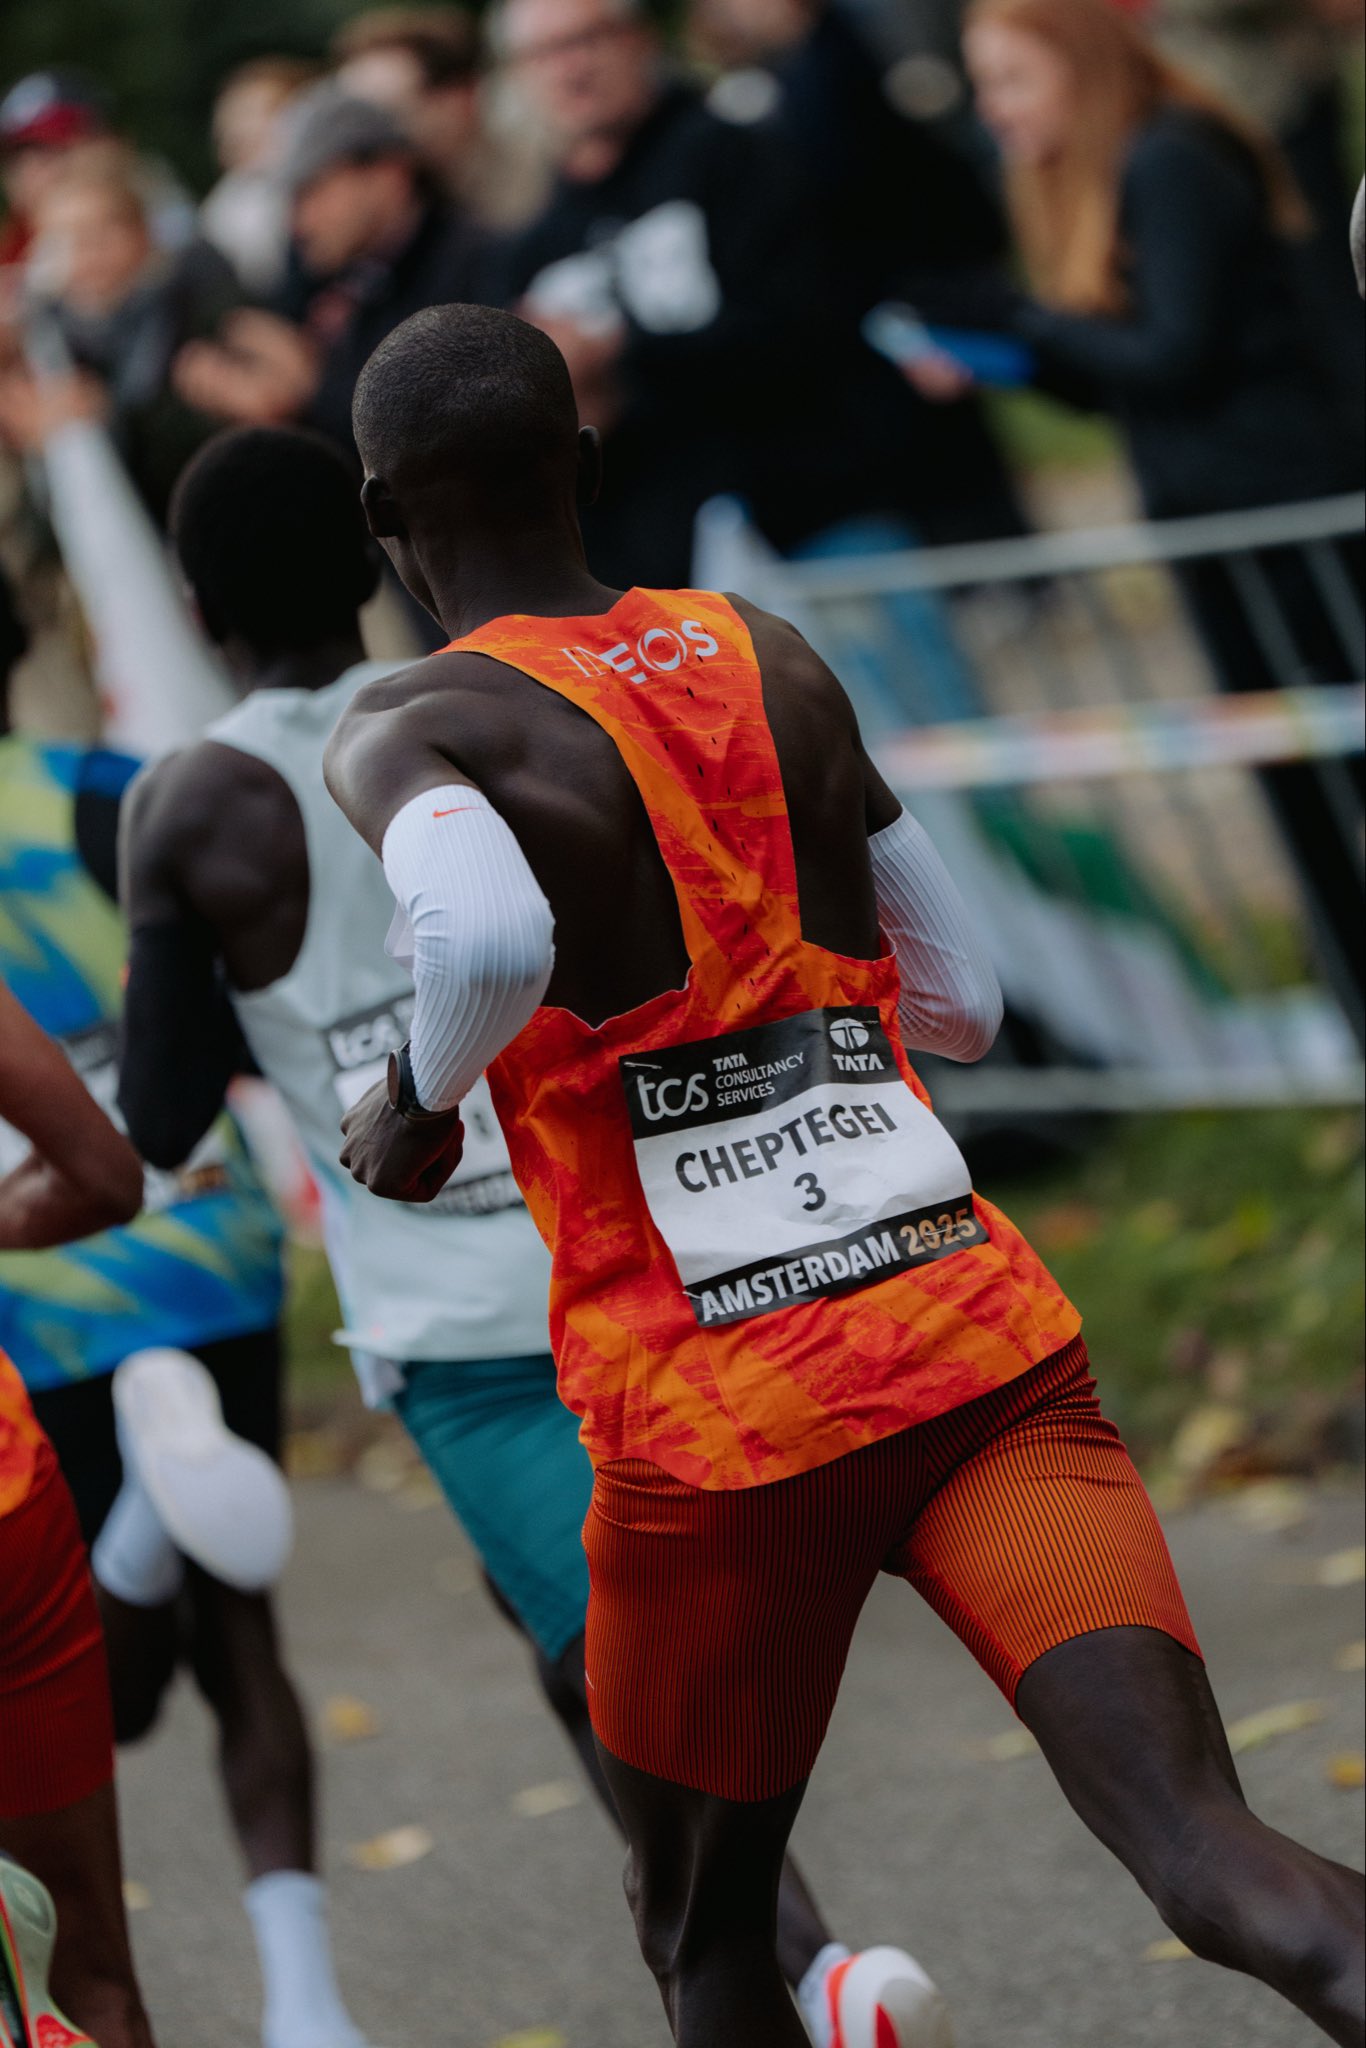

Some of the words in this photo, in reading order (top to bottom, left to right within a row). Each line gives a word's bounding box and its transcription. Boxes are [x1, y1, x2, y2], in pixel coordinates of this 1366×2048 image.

[561, 620, 718, 684] INEOS
[713, 1053, 747, 1072] TATA
[715, 1052, 805, 1090] CONSULTANCY
[833, 1054, 884, 1072] TATA
[637, 1073, 709, 1121] tcs
[717, 1082, 776, 1107] SERVICES
[676, 1103, 897, 1193] CHEPTEGEI
[794, 1173, 827, 1212] 3
[702, 1233, 900, 1321] AMSTERDAM
[901, 1209, 976, 1255] 2025
